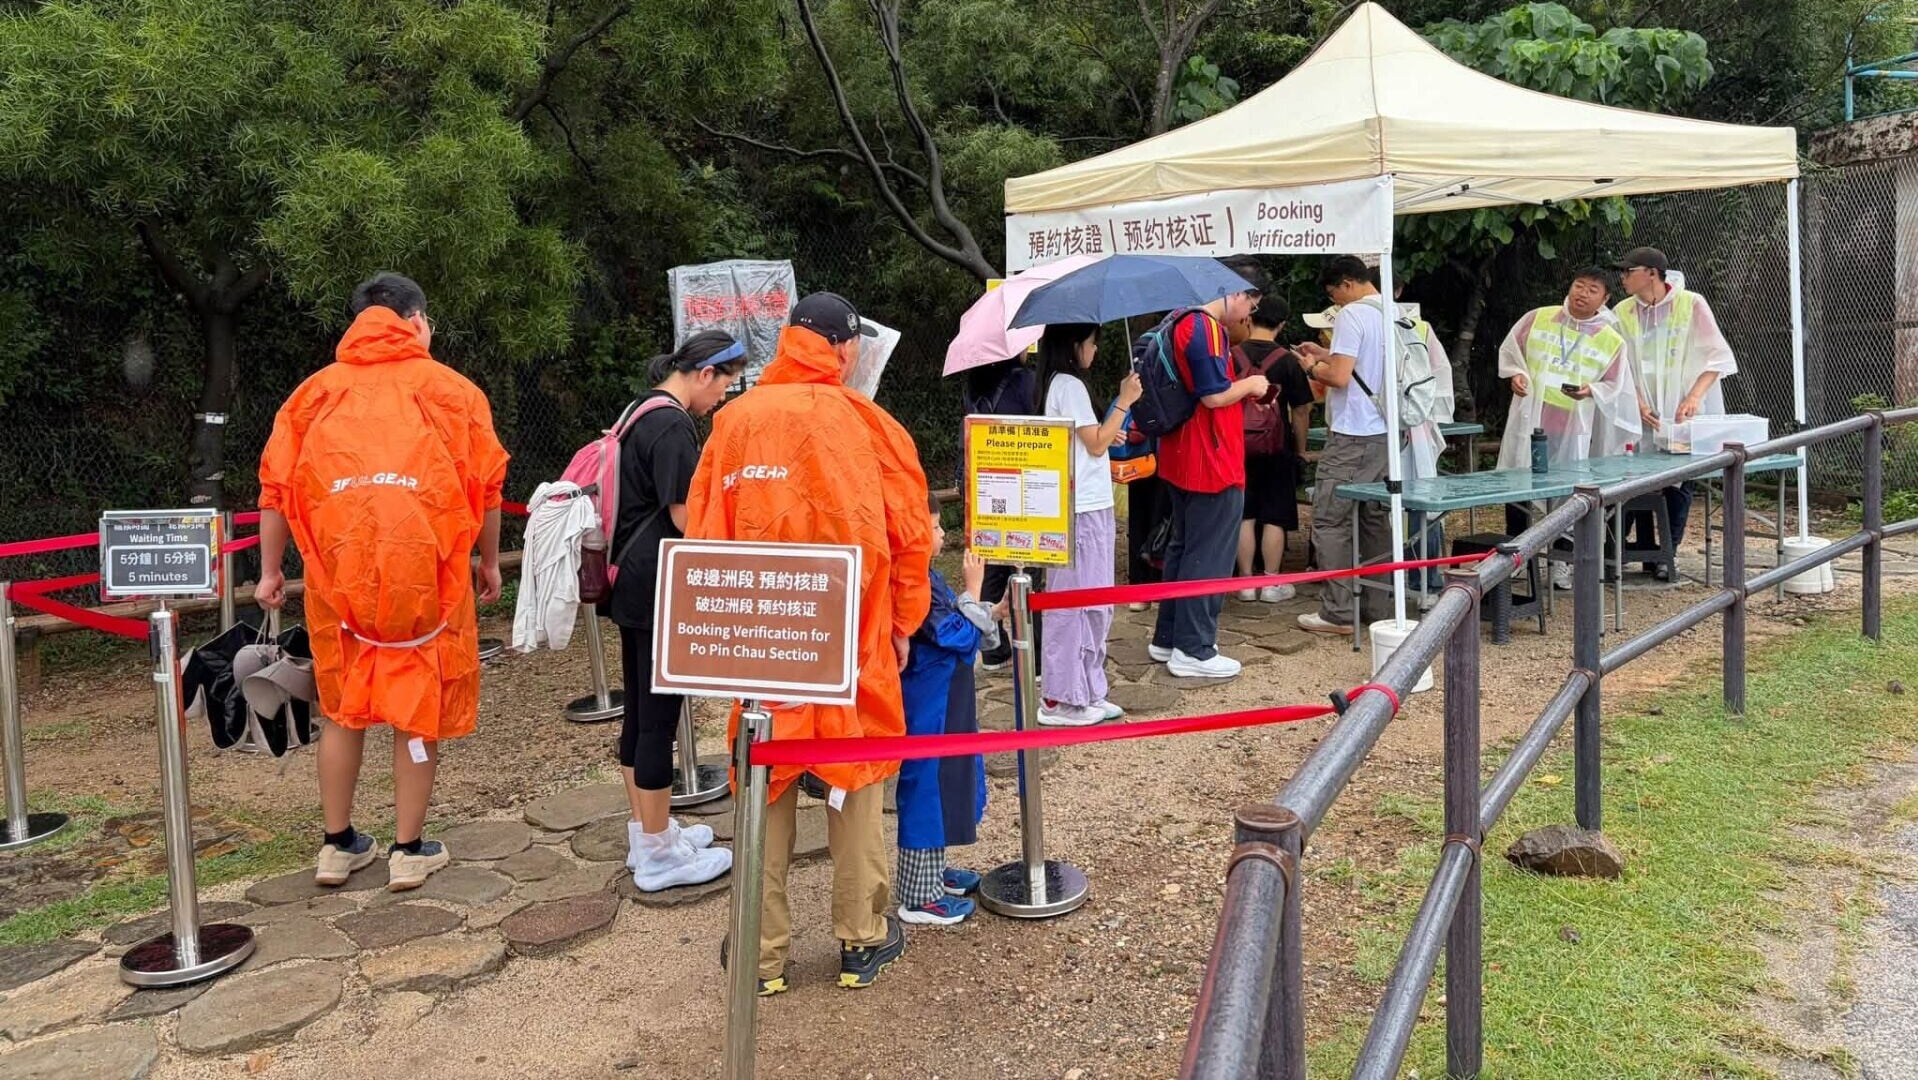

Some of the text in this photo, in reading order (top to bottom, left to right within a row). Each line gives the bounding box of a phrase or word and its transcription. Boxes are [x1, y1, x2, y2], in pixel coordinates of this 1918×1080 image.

[1257, 200, 1323, 223] Booking
[1028, 224, 1103, 260] 預約核證
[1123, 213, 1216, 252] 预约核证
[1247, 229, 1336, 249] Verification
[986, 439, 1053, 450] Please prepare
[129, 534, 189, 544] Waiting Time
[120, 552, 152, 565] 5分鐘
[164, 551, 197, 565] 5分钟
[128, 571, 189, 582] 5 minutes
[686, 568, 829, 592] 破邊洲段 預約核證
[696, 596, 817, 617] 破边洲段 预约核证
[678, 622, 831, 642] Booking Verification for
[690, 643, 818, 661] Po Pin Chau Section
